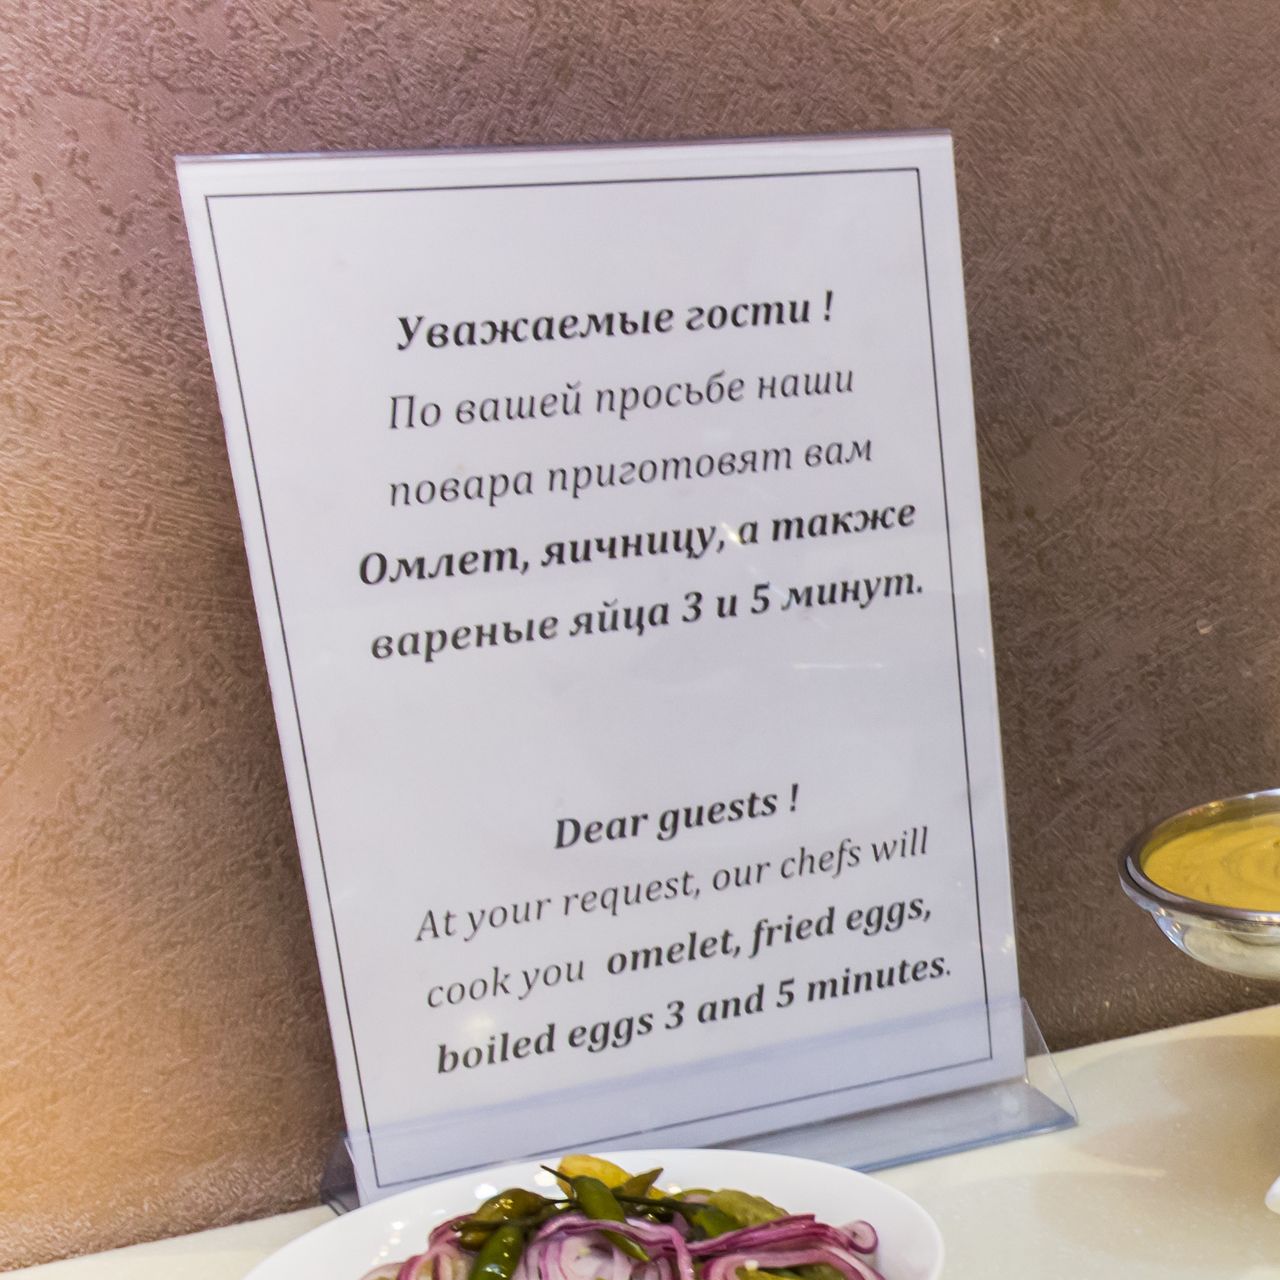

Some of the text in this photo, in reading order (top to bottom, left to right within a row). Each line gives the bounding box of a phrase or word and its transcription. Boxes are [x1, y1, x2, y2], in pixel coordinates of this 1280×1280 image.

[397, 289, 834, 351] Уважаемые гости !
[388, 369, 854, 429] По вашей просьбе наши
[389, 439, 873, 507] повара приготовят вам
[359, 503, 917, 585] Омлет, яичницу, а также
[371, 571, 924, 663] вареные яйца 3 и 5 минут.
[554, 783, 799, 850] Dear guests !
[415, 825, 929, 942] At your request, our chefs will
[427, 897, 932, 1009] cook you omelet, fried eggs,
[437, 956, 951, 1074] boiled eggs 3 and 5 minutes.
